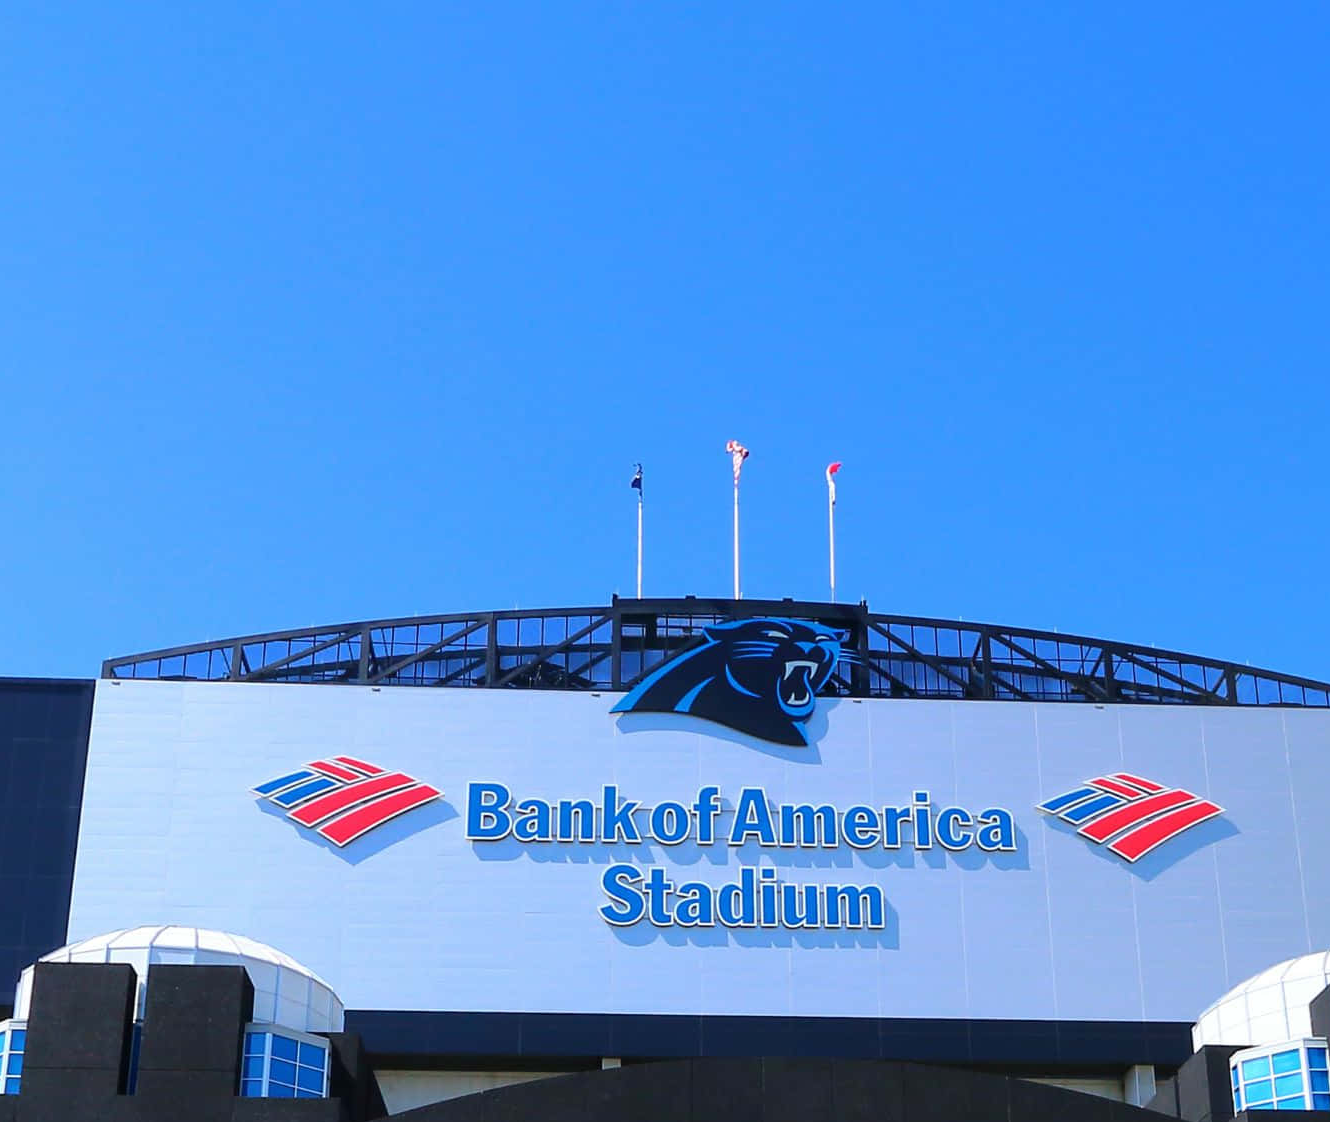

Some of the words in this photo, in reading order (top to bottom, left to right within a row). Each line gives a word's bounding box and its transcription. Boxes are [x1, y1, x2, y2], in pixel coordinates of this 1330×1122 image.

[465, 781, 642, 843] Bank
[650, 785, 723, 846] of
[729, 787, 1017, 852] America
[597, 862, 885, 929] Stadium
